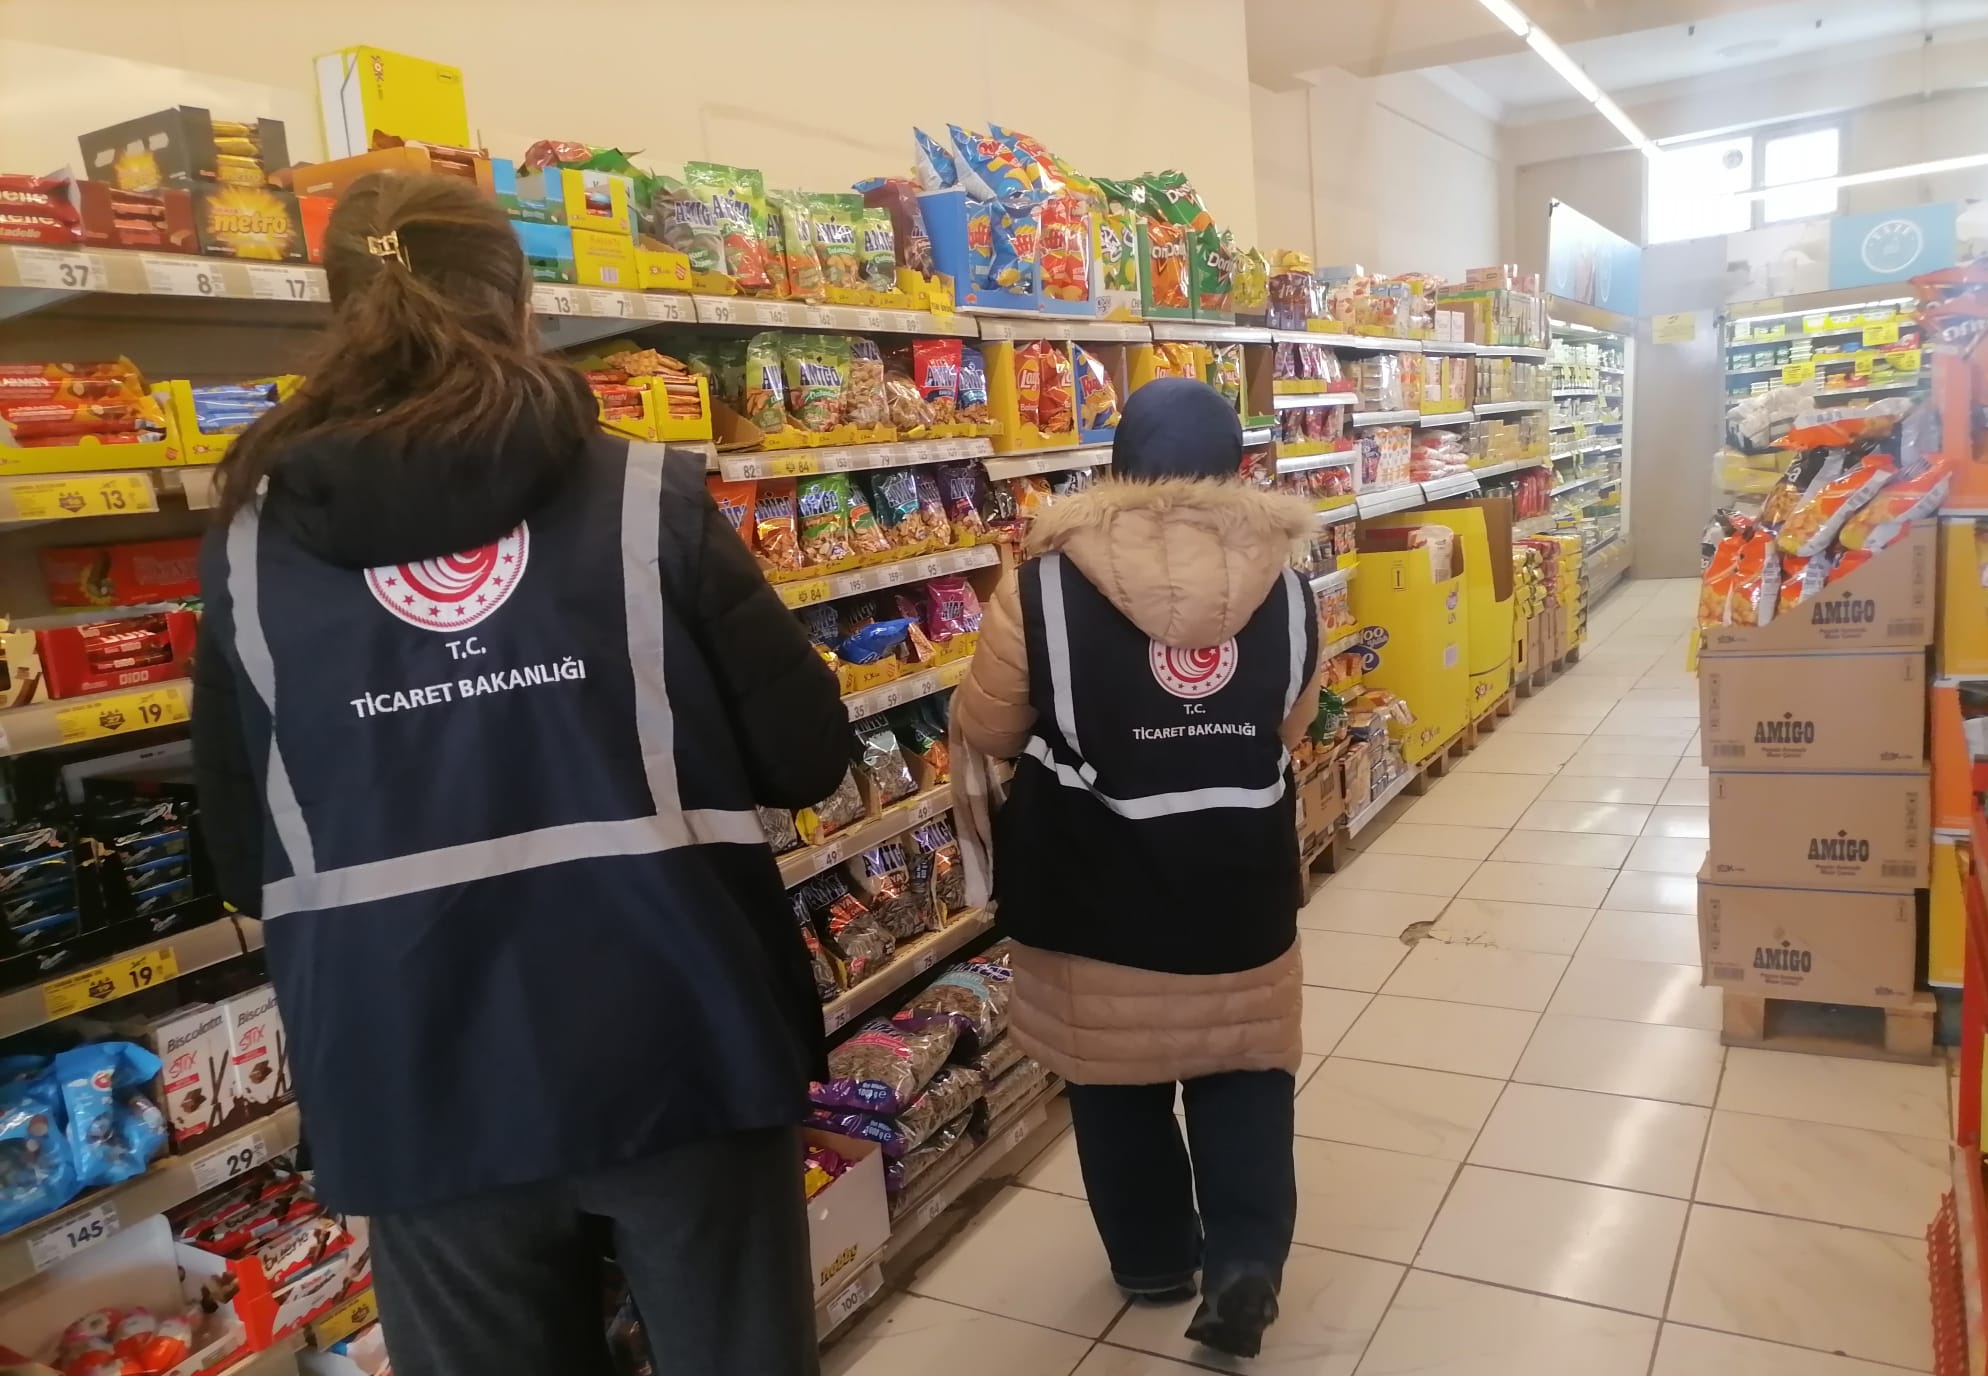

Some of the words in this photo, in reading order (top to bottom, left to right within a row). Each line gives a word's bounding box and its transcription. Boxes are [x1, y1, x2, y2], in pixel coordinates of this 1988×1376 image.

[214, 211, 287, 234] metro
[674, 200, 714, 226] AMIG
[864, 230, 894, 252] AMIG
[59, 263, 89, 287] 37
[196, 274, 212, 294] 8
[286, 279, 305, 299] 17
[554, 296, 571, 313] 13
[617, 300, 625, 316] 7
[664, 304, 678, 319] 75
[715, 308, 729, 321] 99
[801, 363, 841, 387] AMIGO
[798, 462, 809, 473] 84
[880, 455, 890, 465] 79
[743, 466, 757, 478] 82
[101, 490, 126, 510] 13
[928, 564, 937, 575] 95
[811, 589, 821, 600] 84
[1811, 599, 1875, 625] AMIGO
[446, 637, 487, 660] T.C.
[350, 683, 453, 718] TİCARET
[458, 656, 587, 698] BAKANLIĞI
[921, 681, 931, 695] 29
[888, 694, 897, 706] 59
[1183, 703, 1206, 715] T.C.
[138, 703, 162, 724] 19
[854, 705, 865, 718] 35
[1132, 726, 1186, 740] TİCARET
[1188, 723, 1256, 737] BAKANLIĞI
[1754, 720, 1815, 744] AMIGO
[918, 808, 928, 818] 49
[914, 819, 953, 855] AMIG
[826, 853, 837, 865] 49
[1807, 838, 1870, 862] AMIGO
[1753, 947, 1812, 973] AMIGO
[128, 965, 153, 989] 19
[167, 1015, 223, 1054] Biscolata
[227, 1148, 253, 1177] 29
[66, 1220, 104, 1248] 145
[820, 1244, 858, 1286] hobby
[841, 1293, 857, 1312] 100
